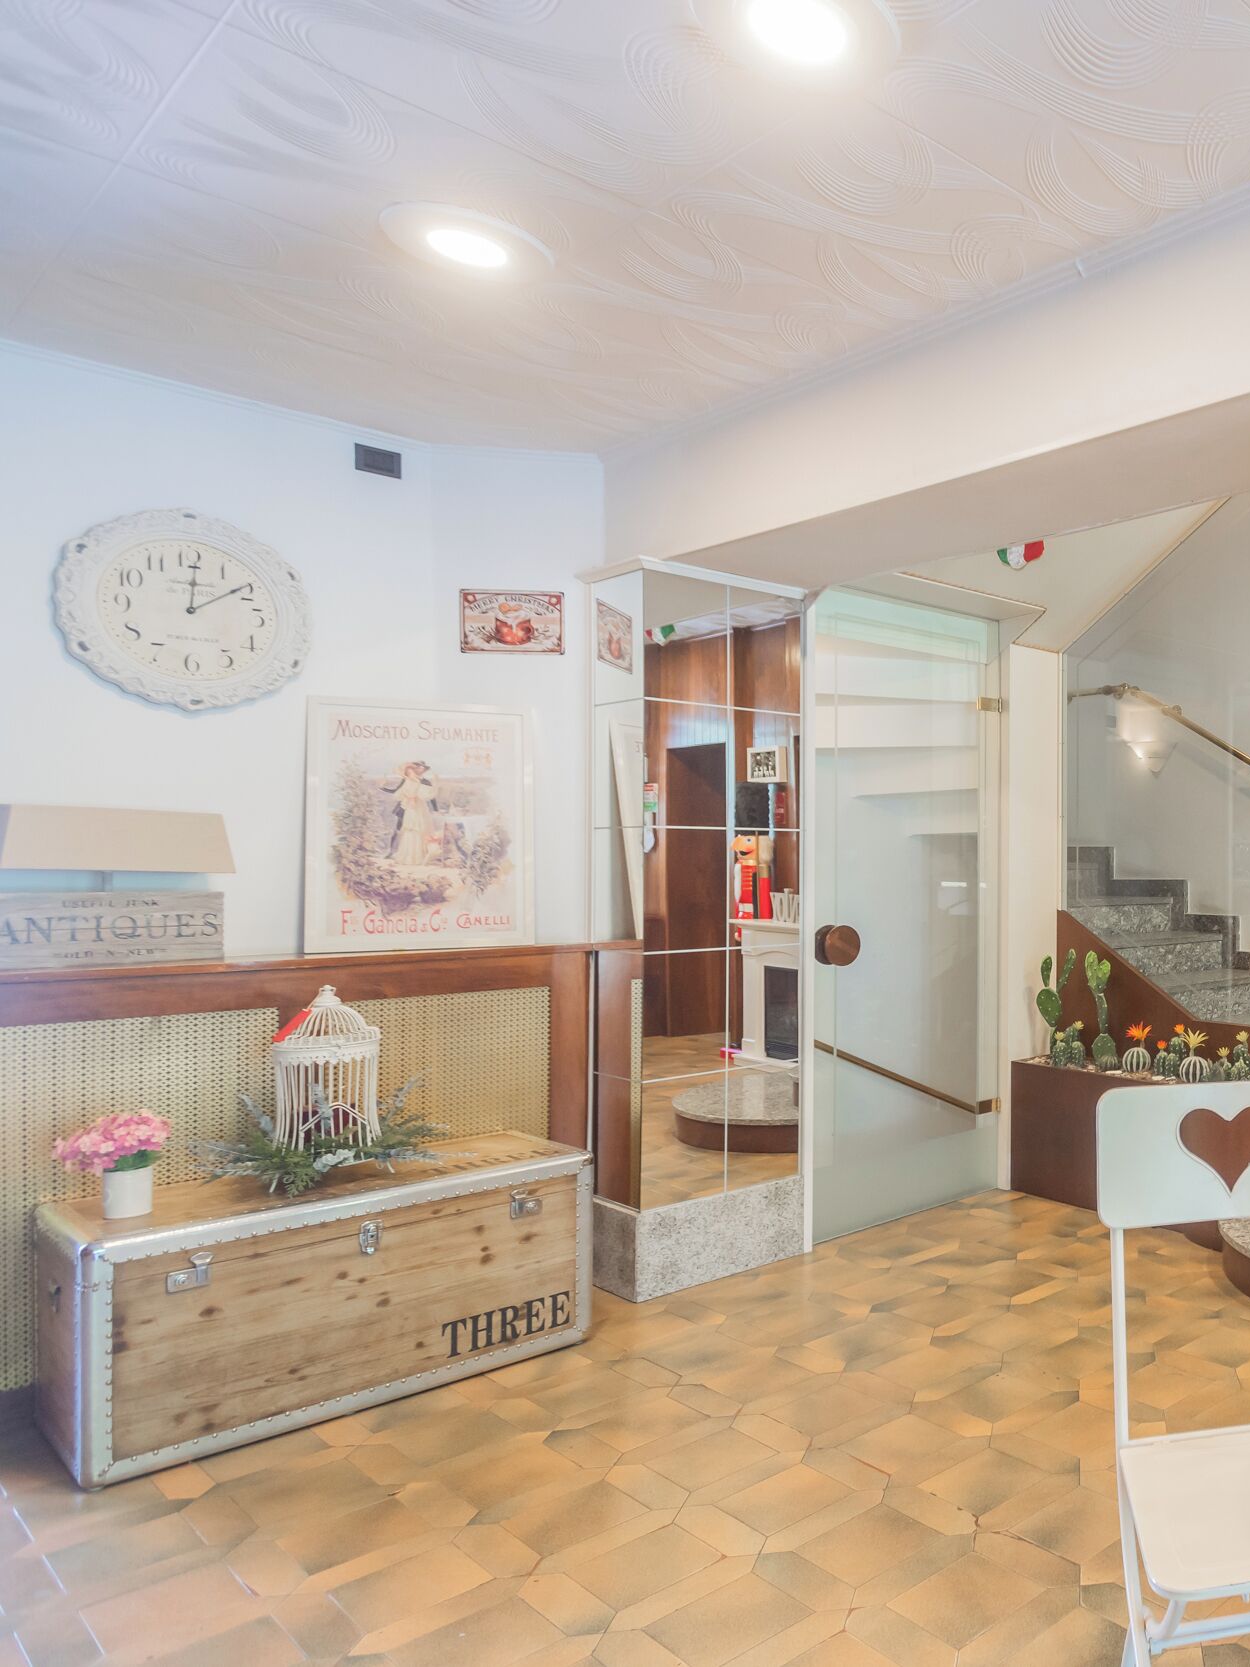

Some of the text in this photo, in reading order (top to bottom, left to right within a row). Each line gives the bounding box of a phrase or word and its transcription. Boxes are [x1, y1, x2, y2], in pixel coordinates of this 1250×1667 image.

[147, 552, 164, 573] 11
[178, 550, 201, 570] 12
[119, 567, 144, 588] 10
[220, 562, 226, 581] 1
[114, 593, 131, 613] 9
[470, 595, 555, 614] MERRY CHRISTMAS
[239, 634, 255, 653] 4
[184, 652, 200, 673] 6
[220, 648, 234, 669] 5
[331, 719, 500, 743] MOSCATO SPUMANTE
[0, 912, 219, 946] ANTIQUES
[456, 912, 511, 929] CANELLI
[441, 1289, 571, 1360] THREE
